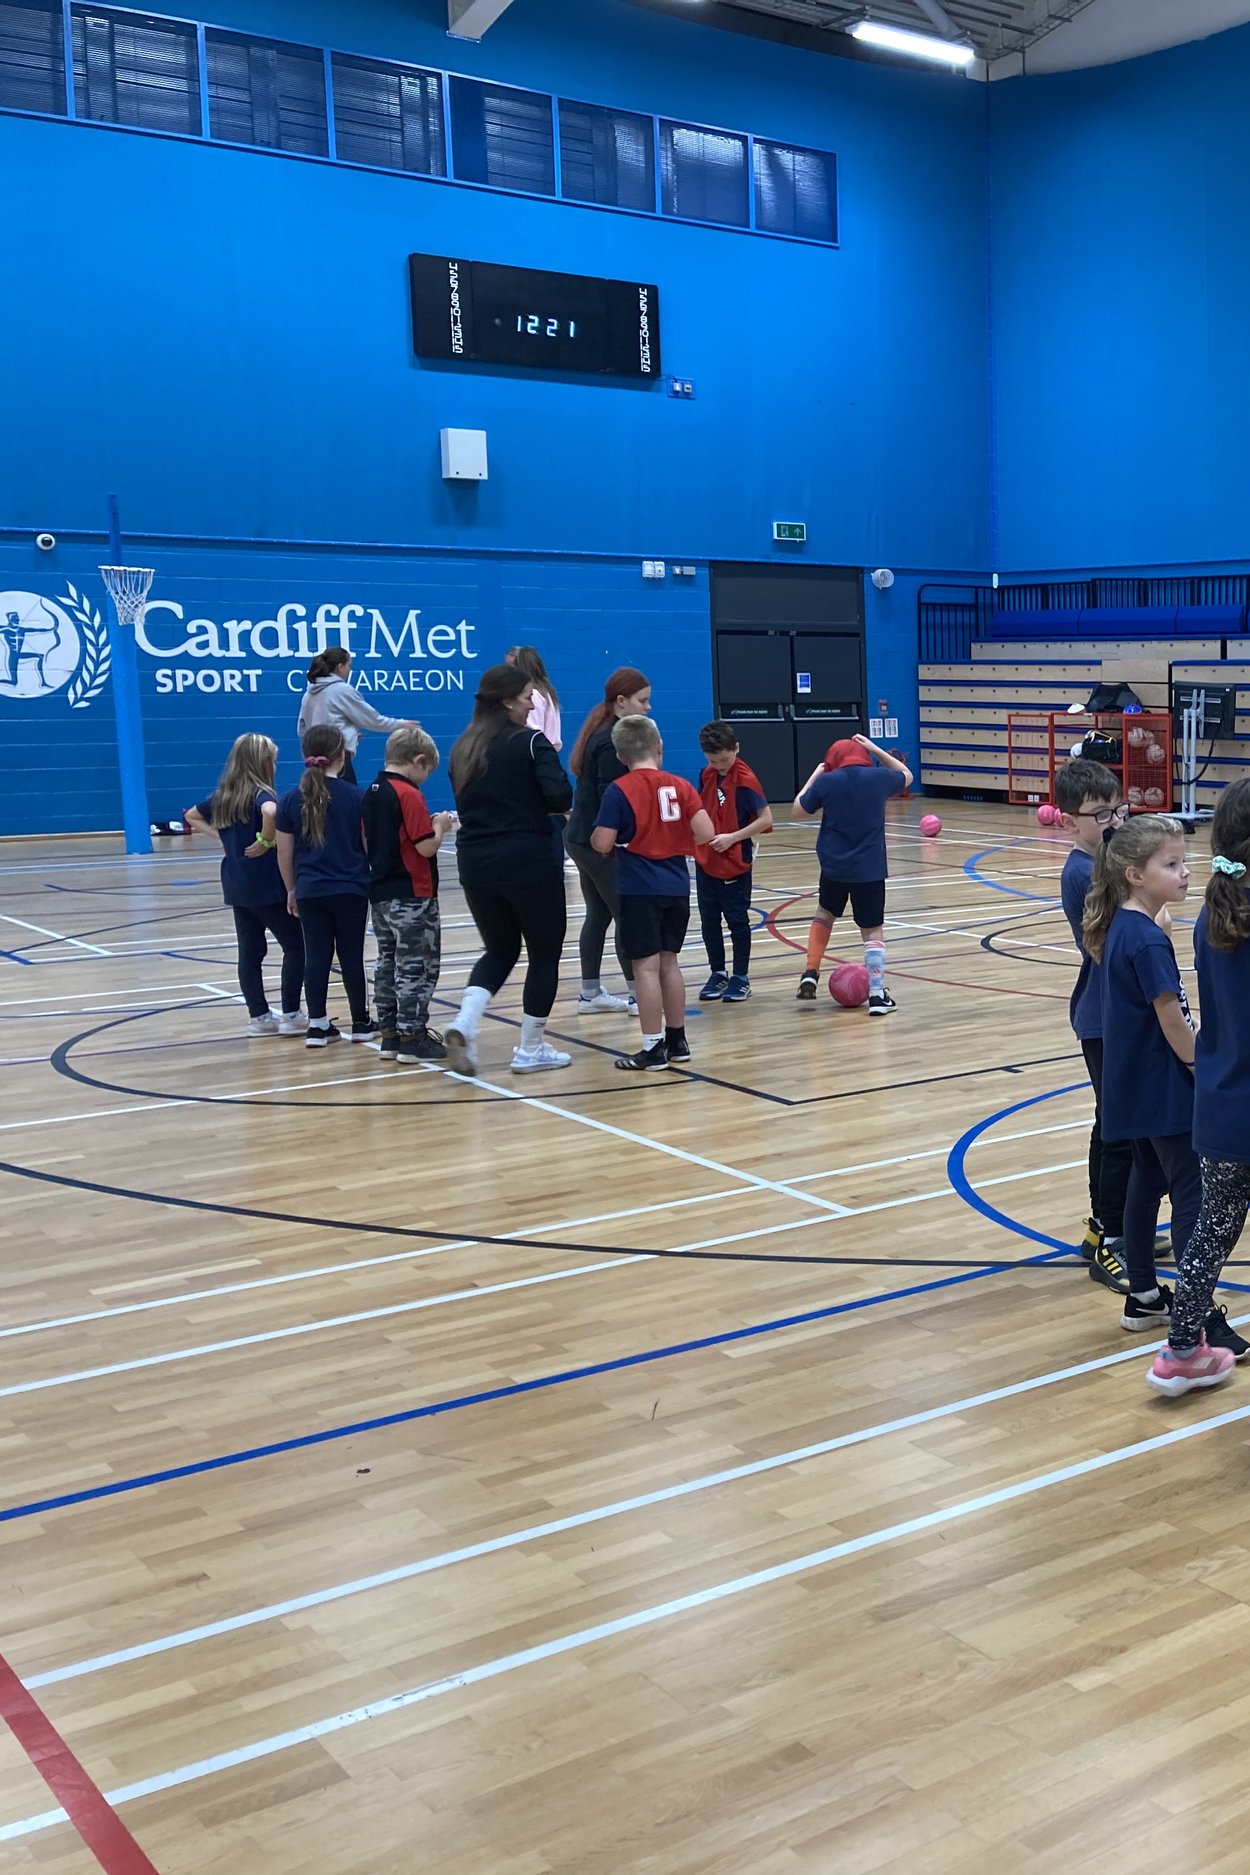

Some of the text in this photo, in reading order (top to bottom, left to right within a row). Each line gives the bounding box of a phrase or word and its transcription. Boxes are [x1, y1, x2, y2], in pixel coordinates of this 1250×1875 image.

[134, 600, 478, 659] Cardiff Met
[156, 669, 464, 693] SPORT CARAEON
